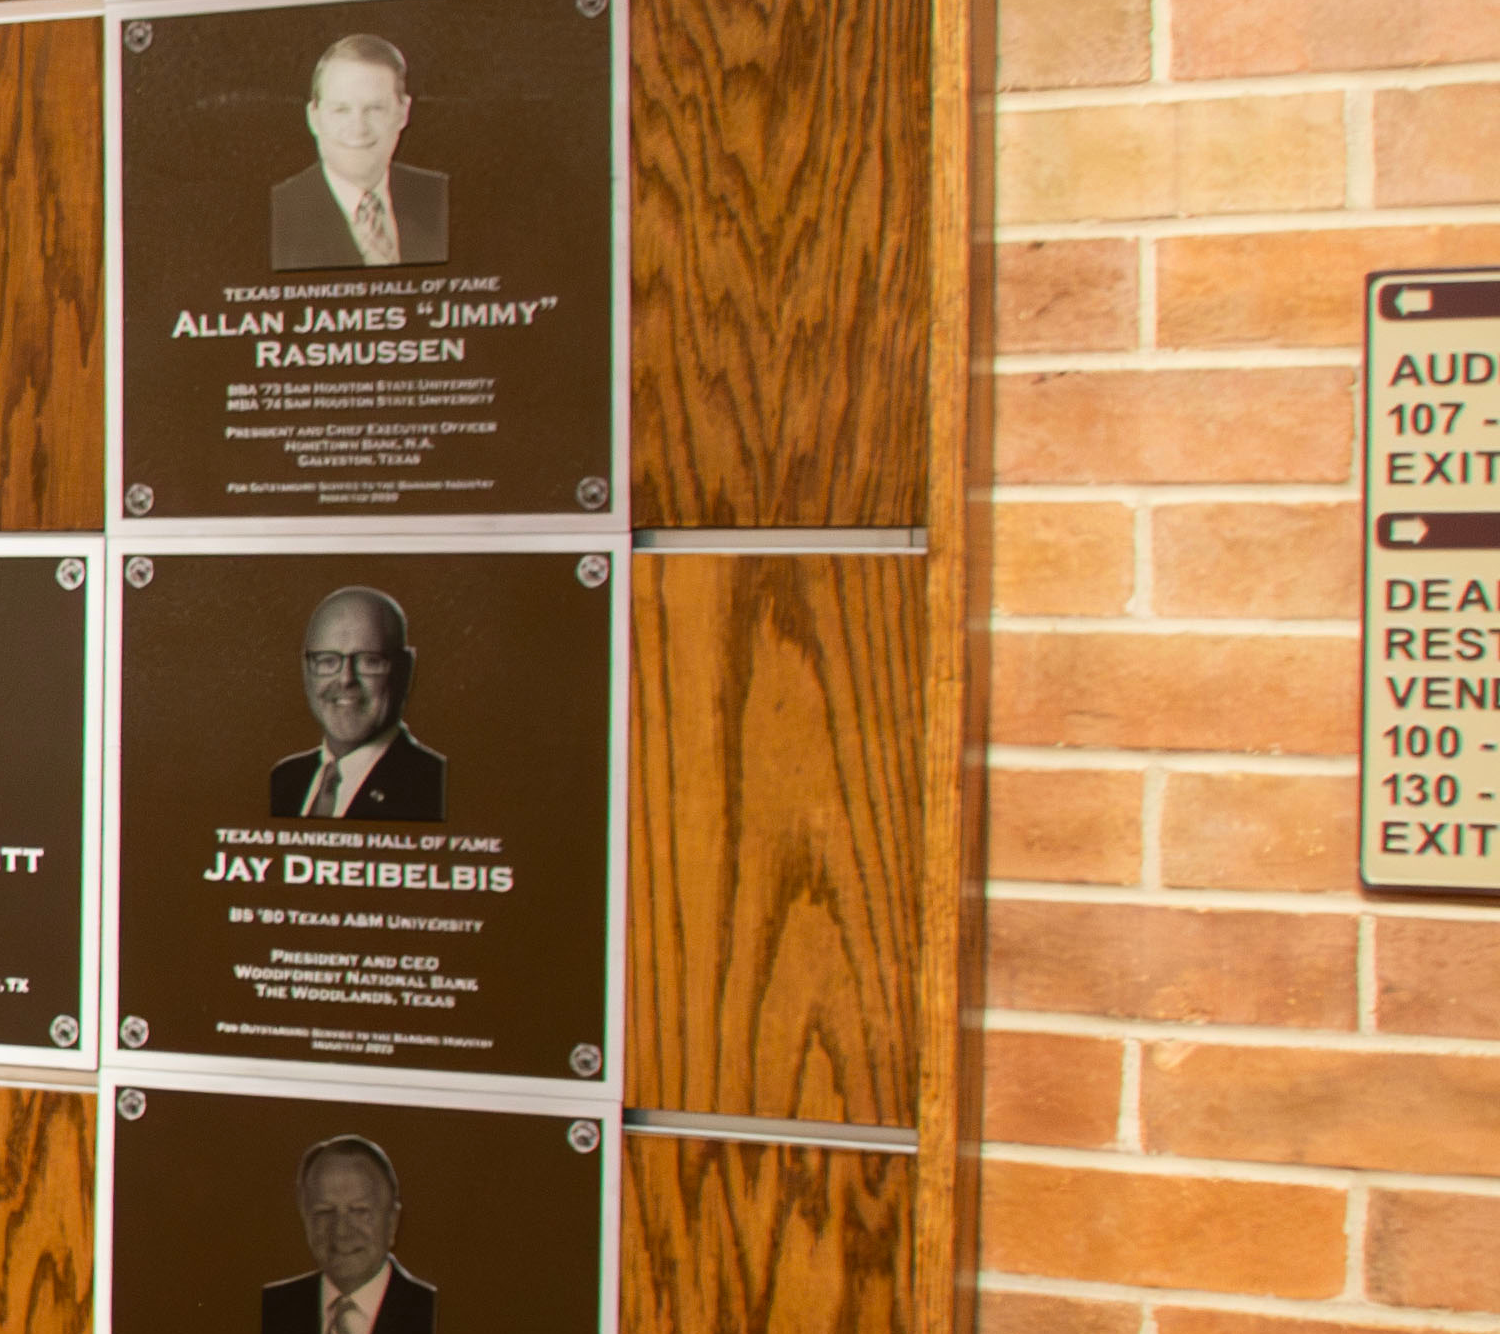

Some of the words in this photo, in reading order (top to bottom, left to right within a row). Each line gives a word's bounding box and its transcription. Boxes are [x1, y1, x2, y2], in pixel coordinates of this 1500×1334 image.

[171, 309, 284, 338] ALLAN
[292, 305, 406, 333] JAMES
[255, 338, 464, 368] RASMUSSEN
[1387, 352, 1500, 386] AUD
[1387, 402, 1467, 435] 107
[1386, 450, 1500, 485] EXIT
[1385, 578, 1500, 612] DEA
[1382, 724, 1462, 758] 100
[1381, 772, 1460, 807] 130
[1380, 821, 1499, 856] EXIT
[202, 851, 272, 882] JAY
[283, 853, 513, 892] DREIBELBIS
